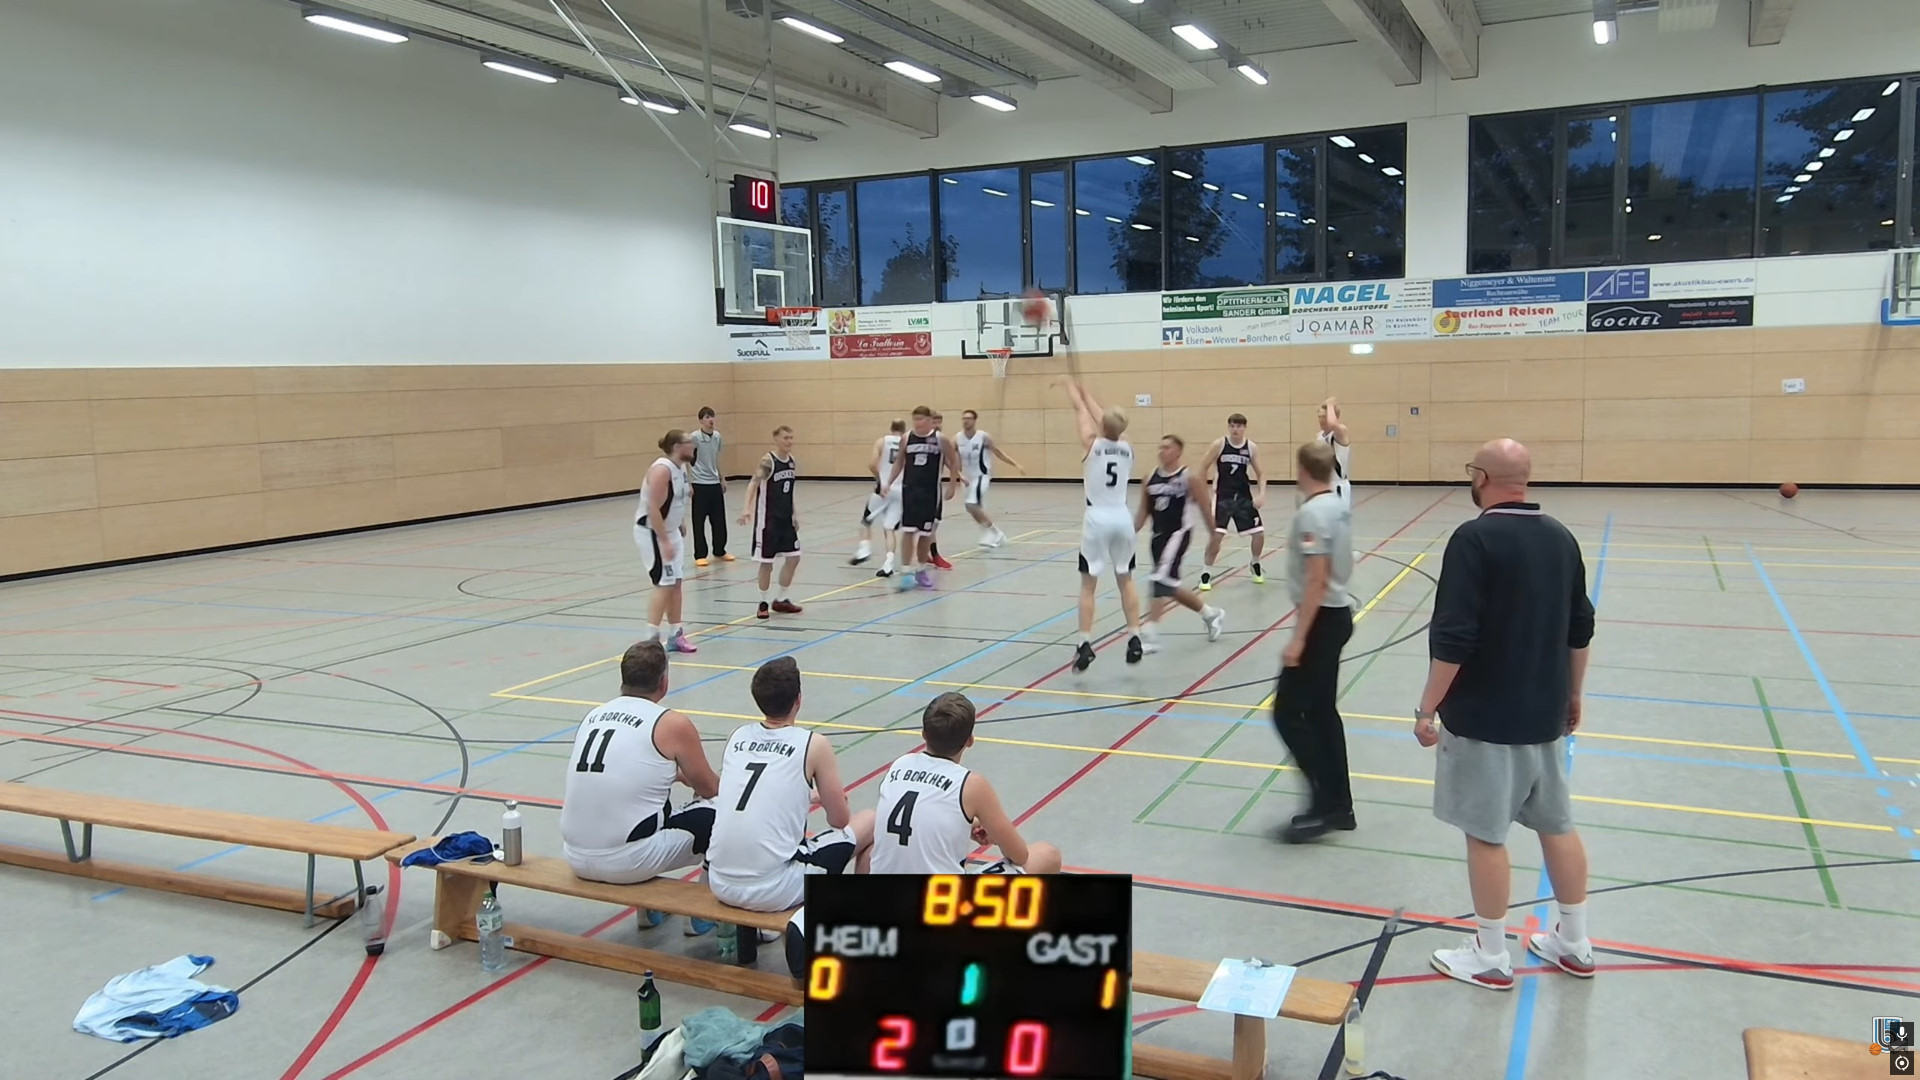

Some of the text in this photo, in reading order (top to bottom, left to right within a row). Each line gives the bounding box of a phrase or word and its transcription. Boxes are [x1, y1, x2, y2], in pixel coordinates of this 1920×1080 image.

[752, 181, 768, 208] 10
[1506, 277, 1514, 285] &
[1216, 295, 1288, 306] OPTITHERM-GLAS
[1294, 284, 1391, 305] NAGEL
[1222, 307, 1283, 317] SANDER GmbH
[1292, 306, 1340, 314] BORCHENER
[1509, 306, 1554, 317] Reisen
[907, 317, 923, 326] LVM
[1297, 315, 1374, 333] JOAMAR
[1591, 316, 1661, 328] GOCKEL
[1186, 325, 1224, 334] Volksbank
[1106, 462, 1118, 487] 5
[1230, 464, 1239, 475] 7
[782, 480, 791, 493] 8
[588, 711, 645, 729] SC BORCHEN
[576, 728, 616, 773] 11
[734, 741, 796, 758] SC BORCHEN
[735, 762, 768, 811] 7
[890, 768, 953, 792] SC BORCHEN
[886, 790, 919, 846] 4
